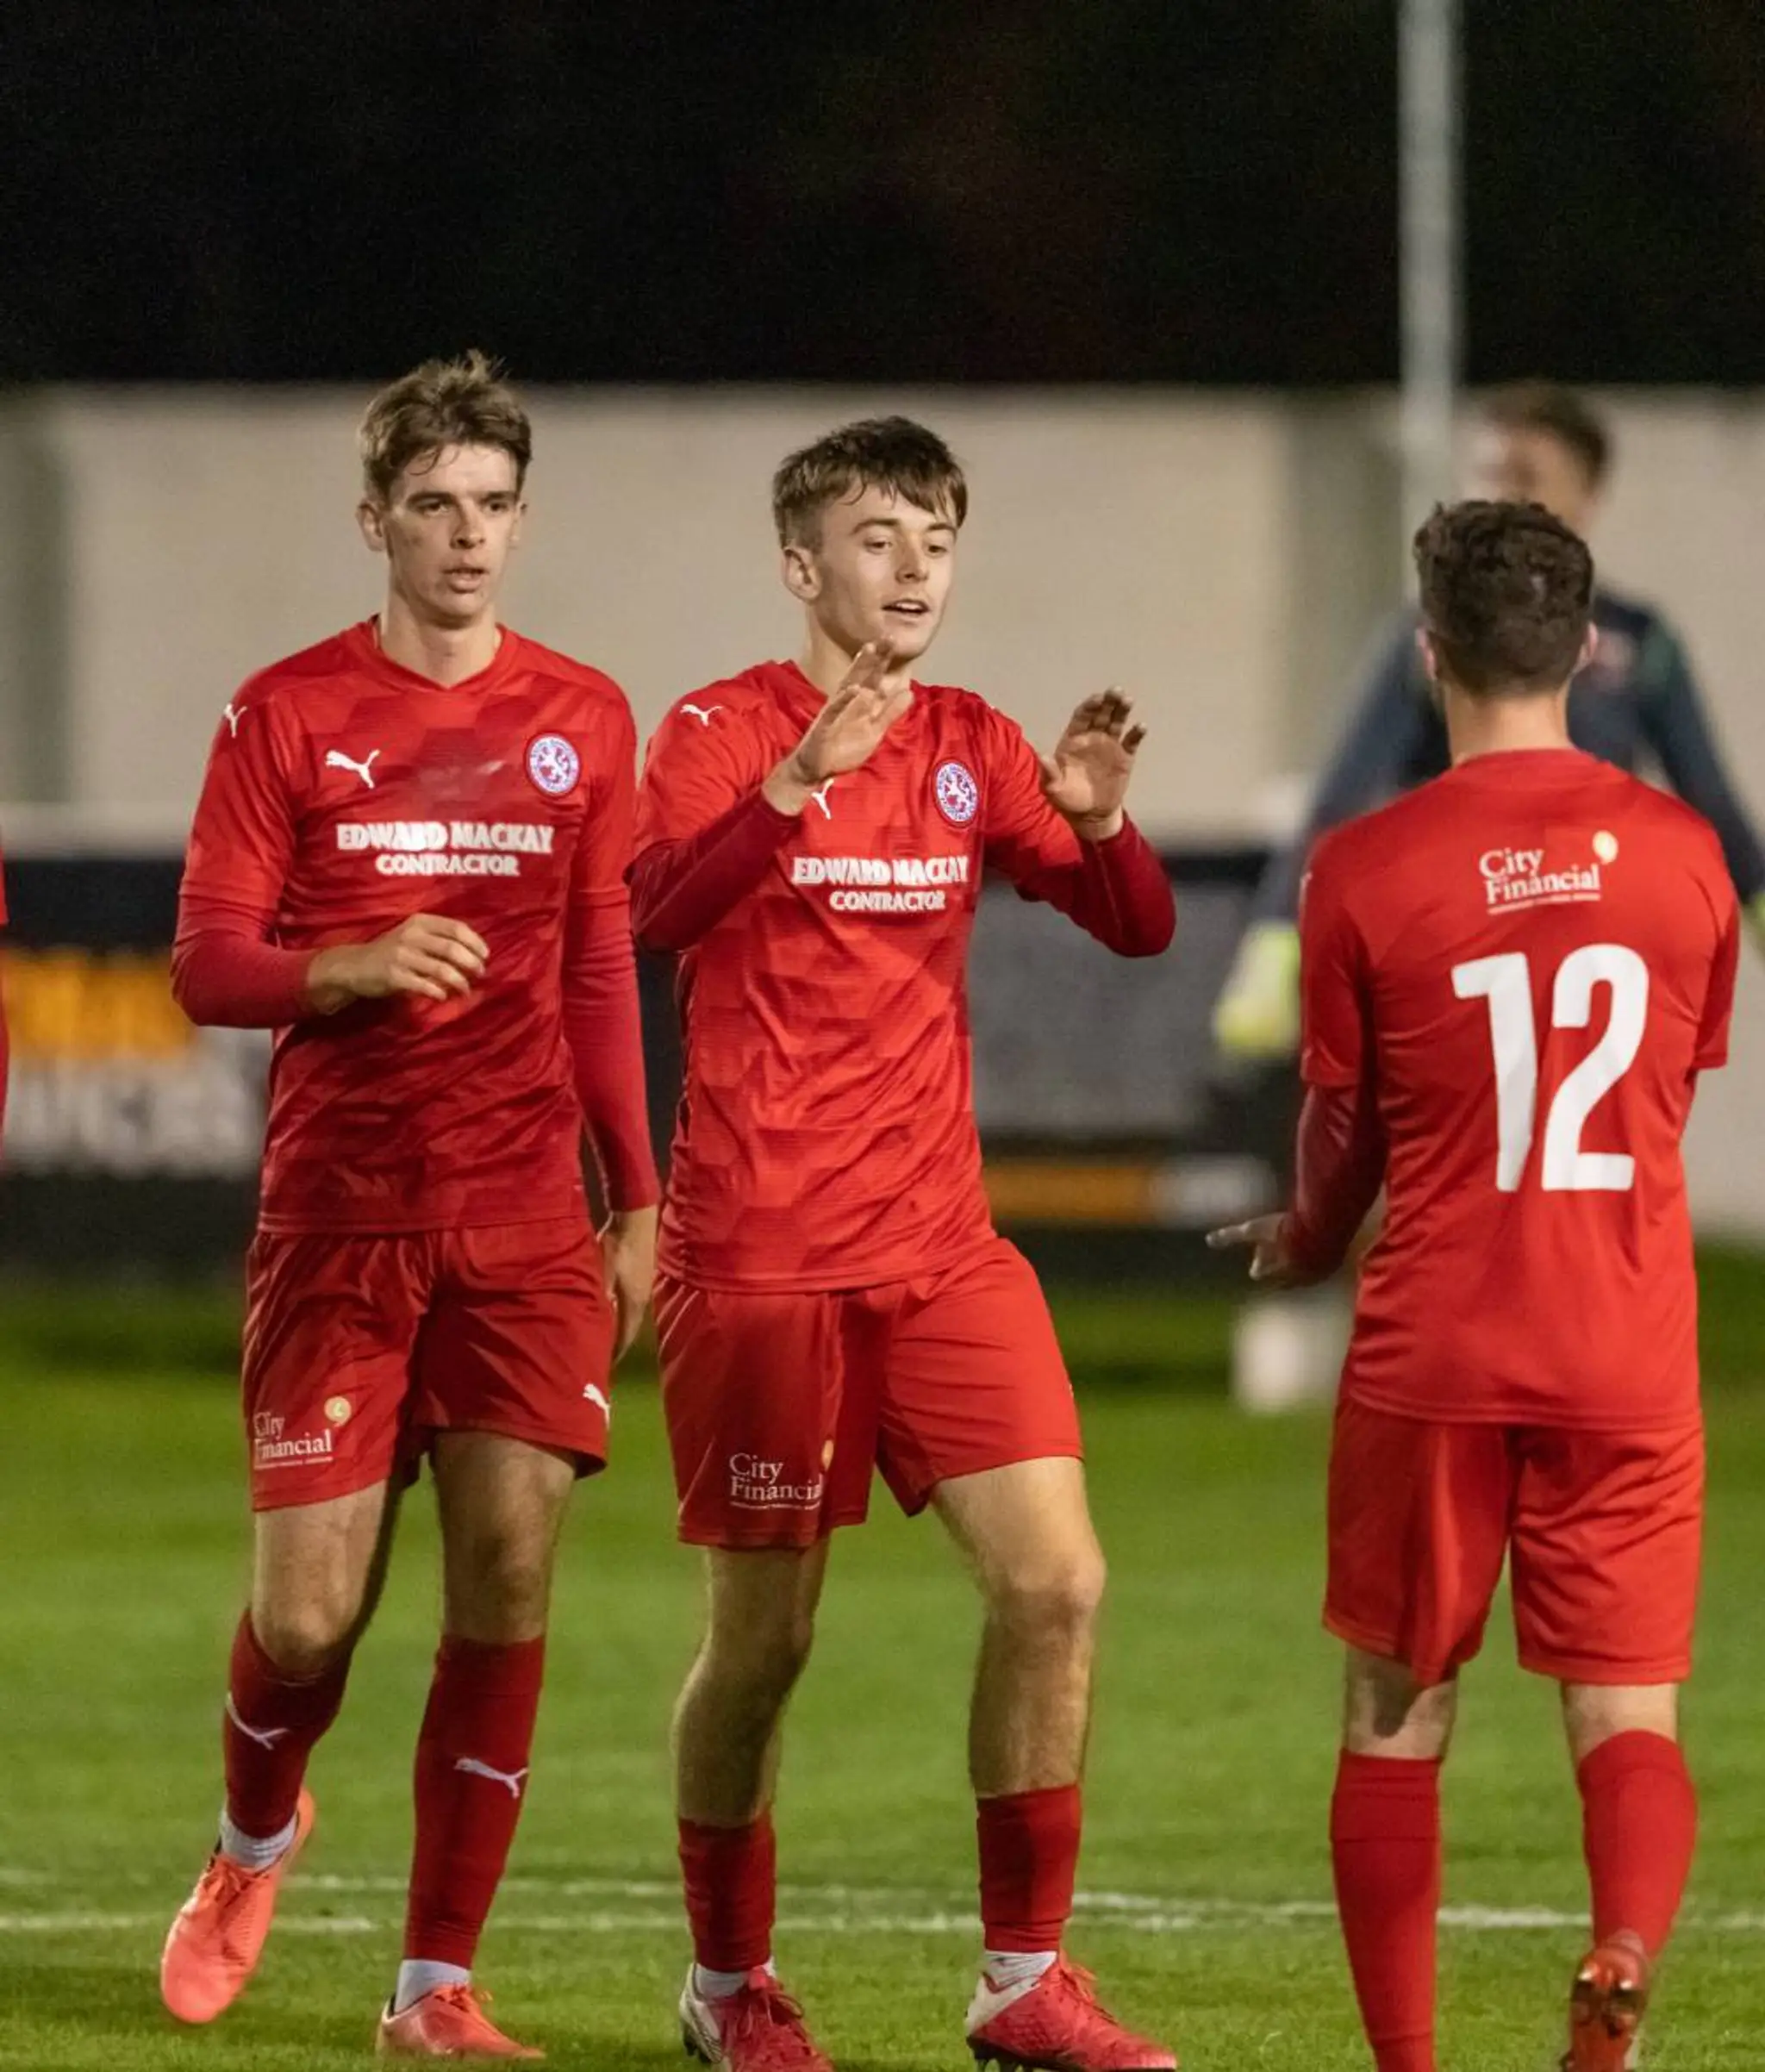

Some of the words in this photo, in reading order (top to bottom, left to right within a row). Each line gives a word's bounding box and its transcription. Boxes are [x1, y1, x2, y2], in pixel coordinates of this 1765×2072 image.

[337, 821, 448, 851] EDWARD
[449, 821, 554, 853] MACKAY
[375, 853, 520, 877] CONTRACTOR
[794, 857, 890, 886] EDWARD
[891, 856, 969, 886] MACKAY
[1479, 847, 1544, 880] City
[1486, 863, 1601, 904] Financial
[829, 890, 945, 912] CONTRACTOR
[1450, 943, 1650, 1192] 12
[729, 1452, 783, 1484] City
